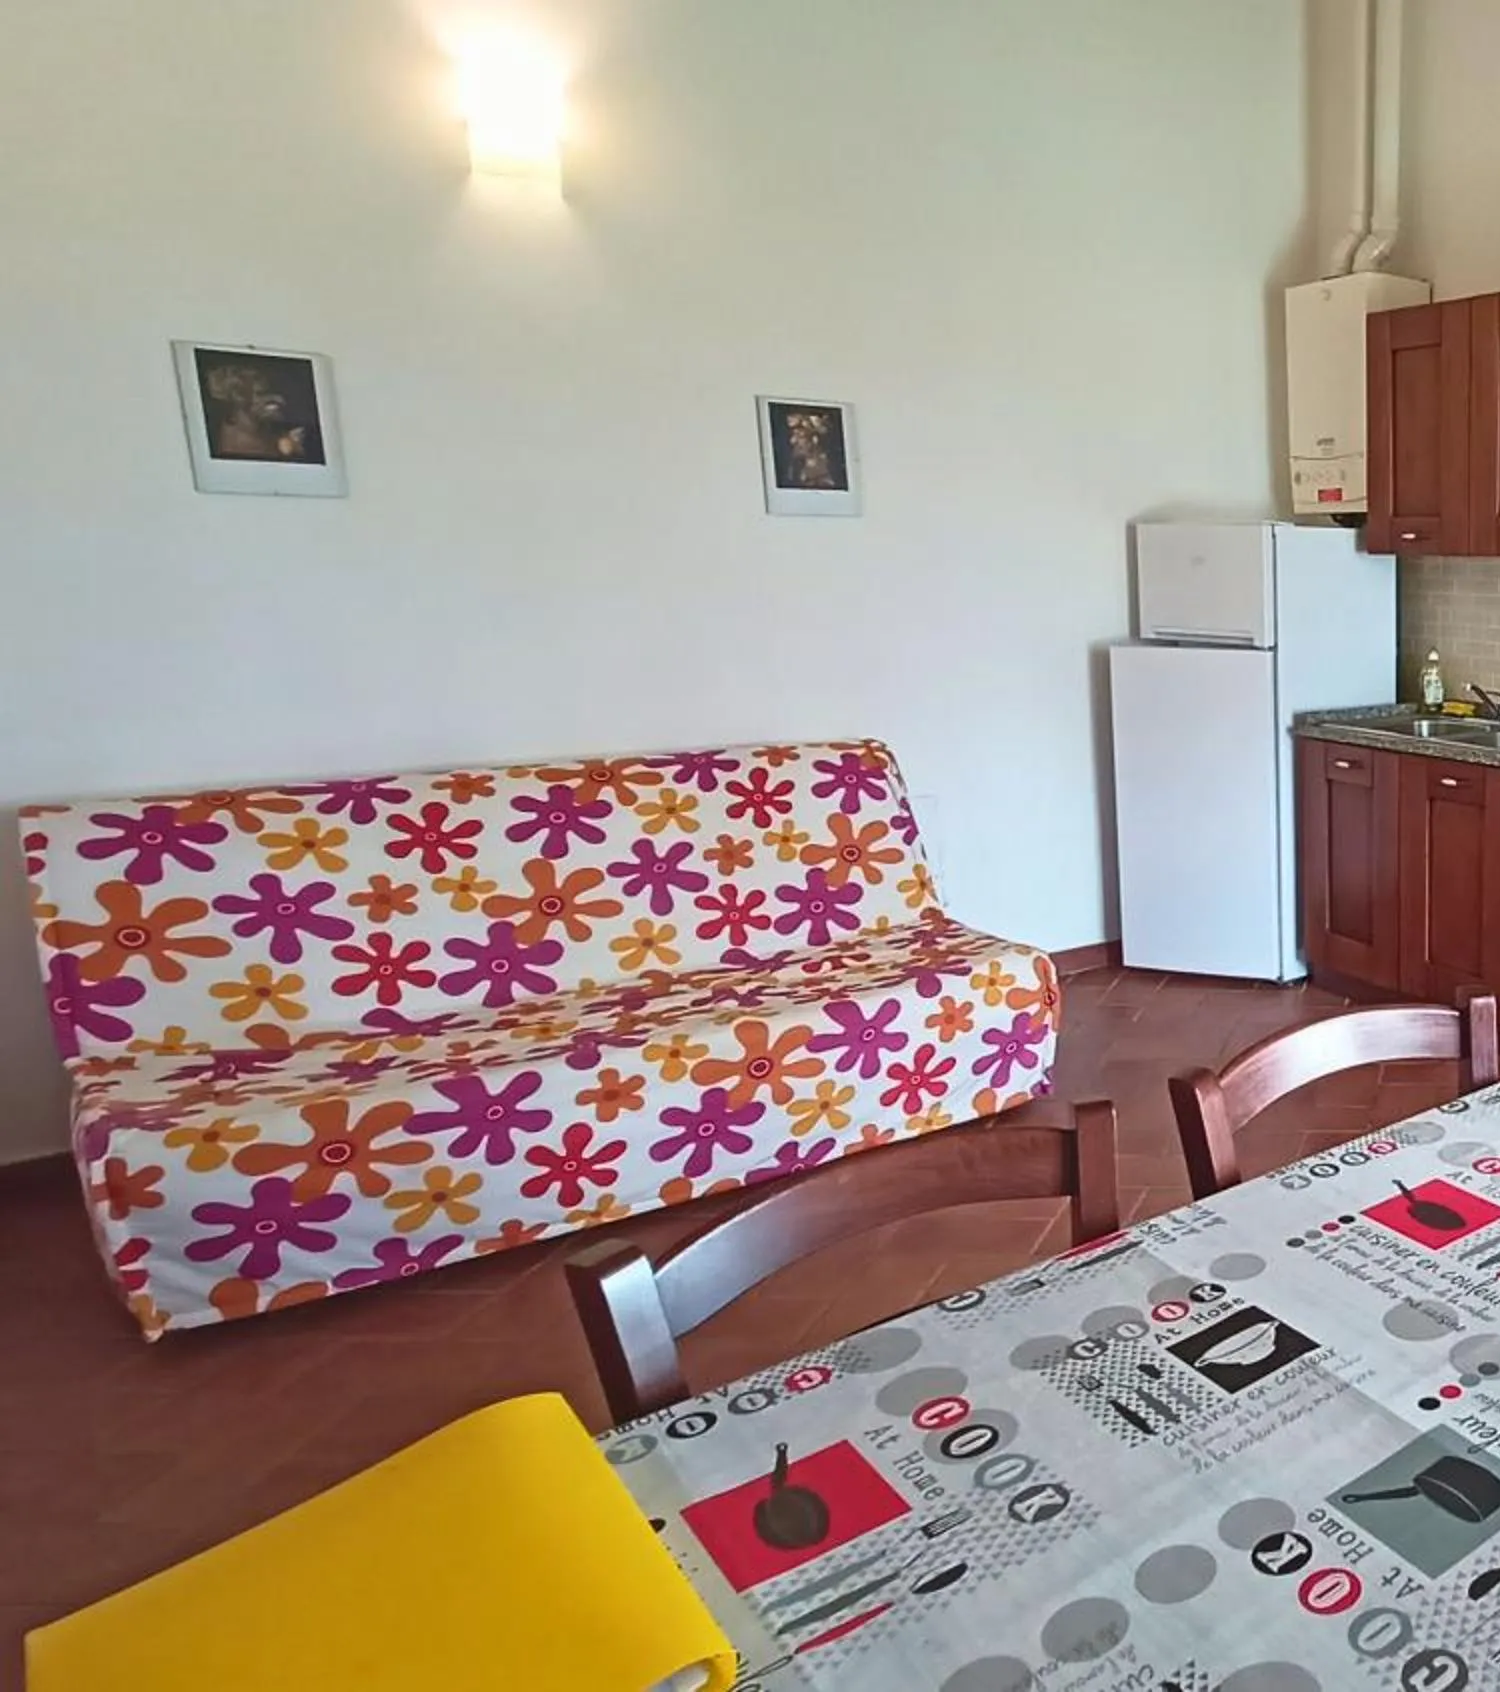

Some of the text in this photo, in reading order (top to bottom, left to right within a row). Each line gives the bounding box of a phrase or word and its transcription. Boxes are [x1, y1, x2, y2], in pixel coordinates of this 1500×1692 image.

[1350, 1225, 1420, 1262] cuisiner
[1415, 1257, 1441, 1274] en
[1068, 1282, 1226, 1360] COOK
[1152, 1296, 1246, 1345] At Home
[912, 1396, 1071, 1523] COOK
[1163, 1399, 1242, 1447] cuisiner
[864, 1425, 946, 1501] At Home
[1307, 1507, 1424, 1599] At Home
